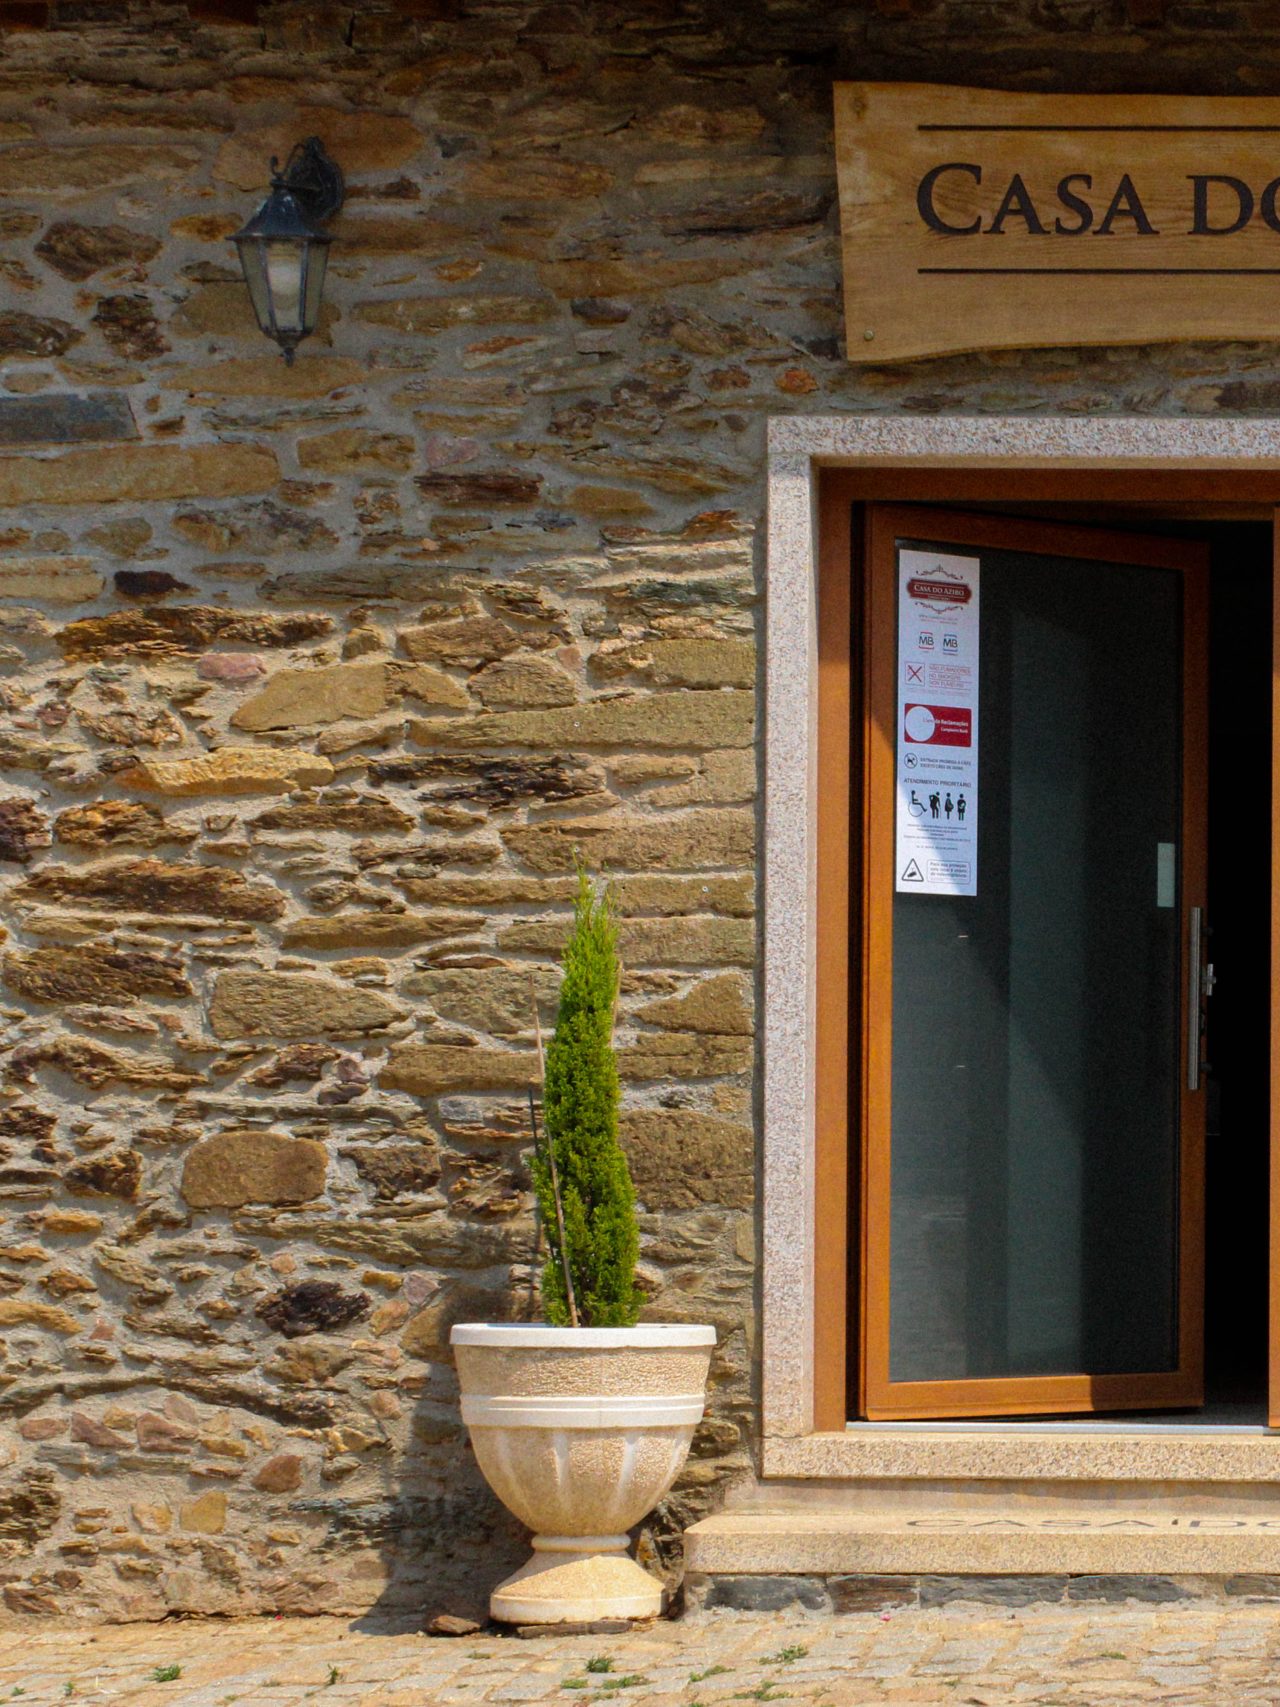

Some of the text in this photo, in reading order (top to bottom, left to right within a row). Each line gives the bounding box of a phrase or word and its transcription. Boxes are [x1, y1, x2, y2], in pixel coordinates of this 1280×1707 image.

[916, 162, 1160, 236] CASA
[919, 636, 934, 646] MB
[943, 638, 958, 648] MB
[904, 777, 938, 786] ATENDIMENTO
[906, 1519, 1156, 1528] CASA
